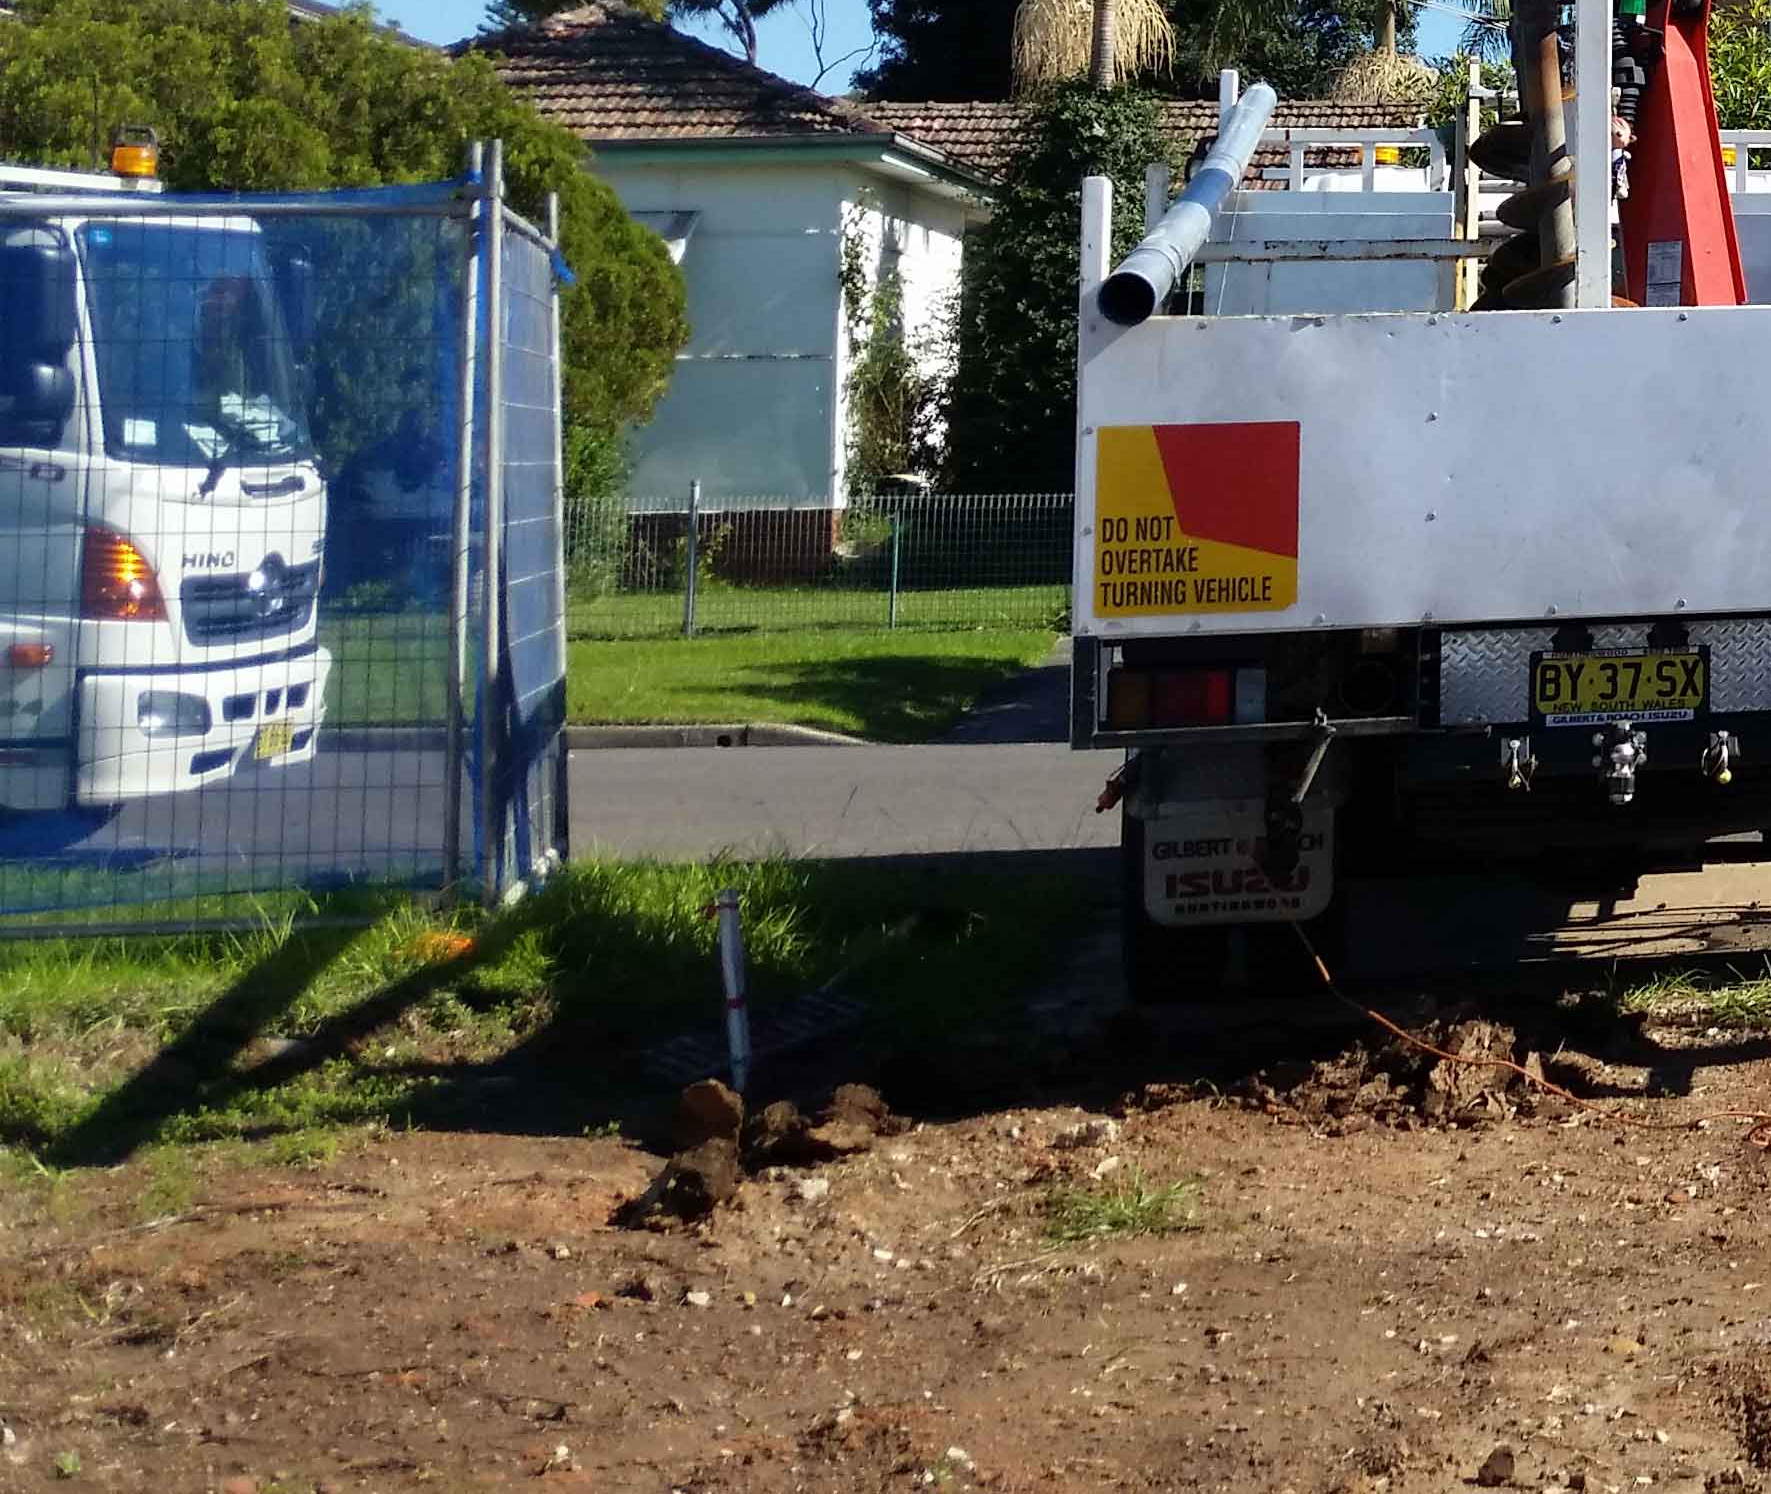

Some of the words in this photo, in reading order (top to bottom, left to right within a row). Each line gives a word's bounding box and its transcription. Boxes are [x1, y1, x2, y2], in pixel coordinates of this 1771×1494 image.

[1102, 517, 1128, 543] DO
[1135, 516, 1174, 542] NOT
[182, 552, 235, 568] HINO
[1101, 547, 1199, 575] OVERTAKE
[1100, 579, 1186, 607] TURNING
[1193, 576, 1272, 603] VEHICLE
